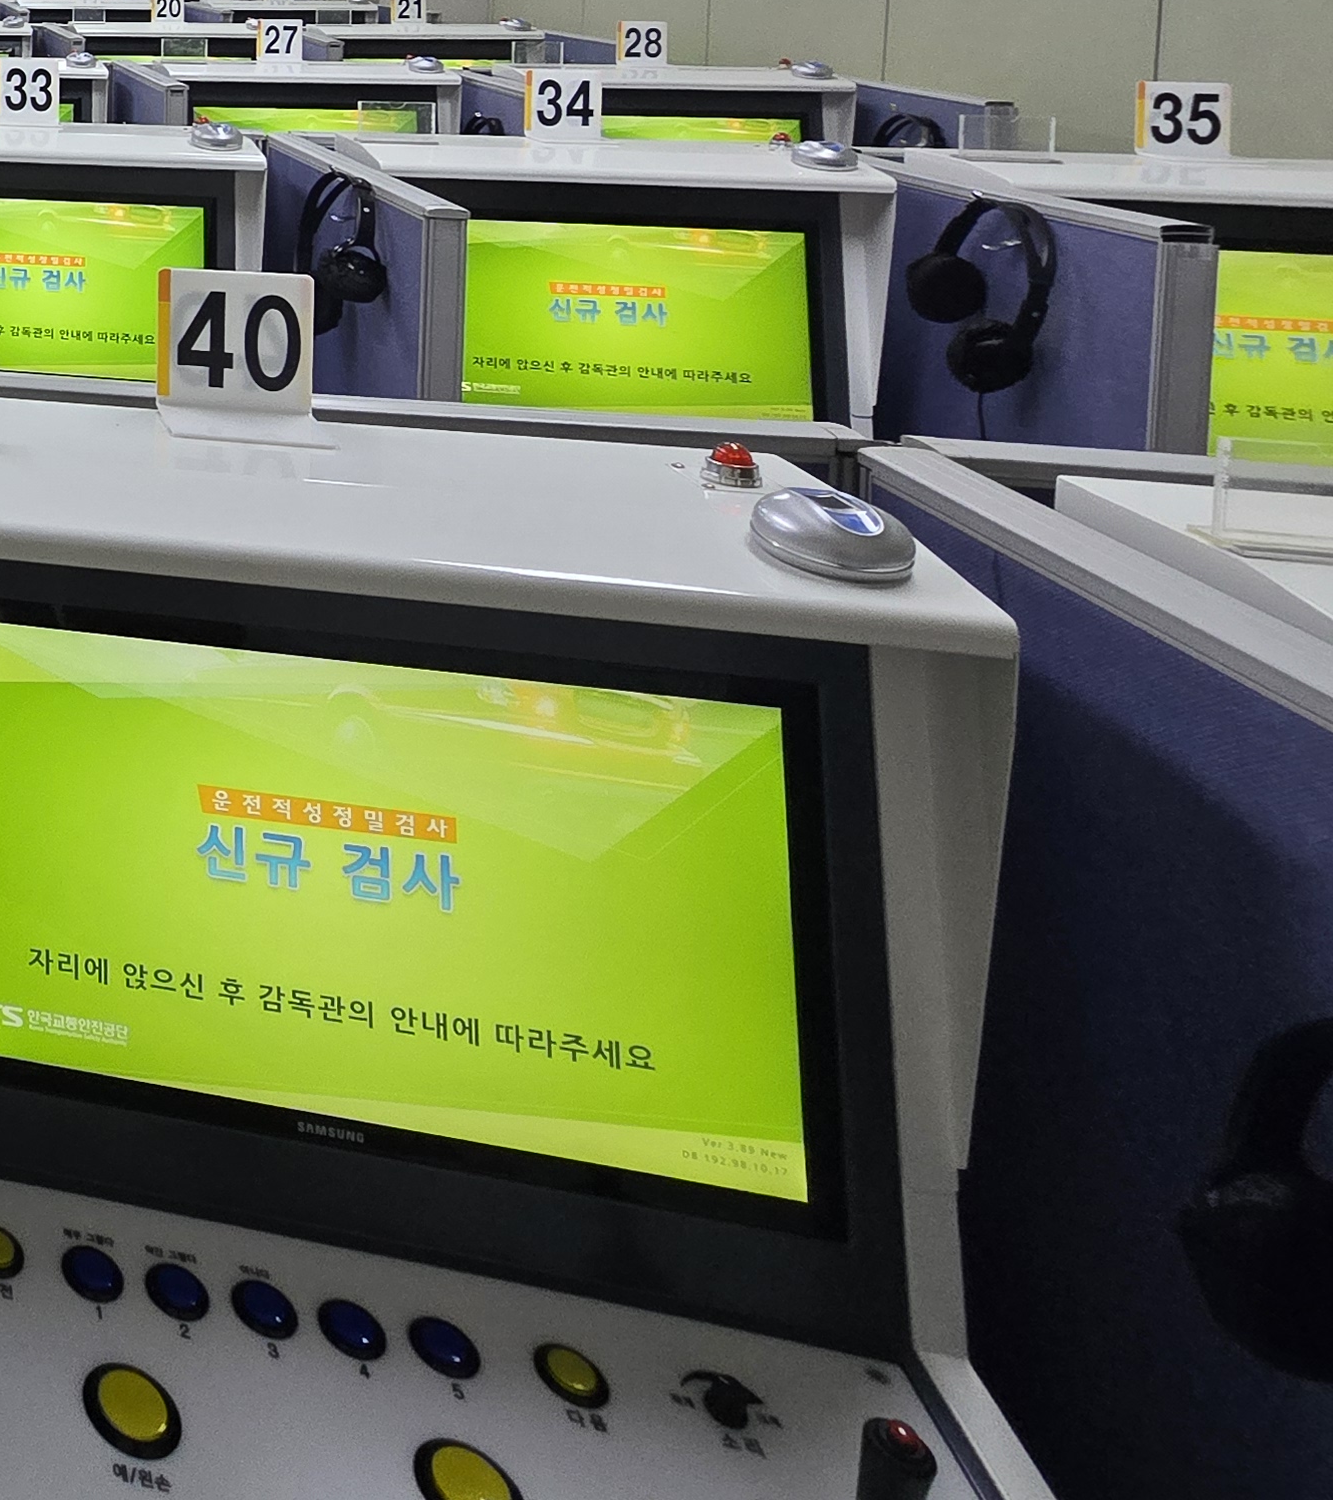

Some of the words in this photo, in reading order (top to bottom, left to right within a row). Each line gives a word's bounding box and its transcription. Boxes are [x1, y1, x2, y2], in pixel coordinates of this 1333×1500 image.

[265, 26, 297, 53] 27
[625, 28, 661, 57] 28
[5, 68, 52, 111] 33
[537, 80, 594, 126] 34
[1151, 93, 1221, 145] 35
[42, 270, 86, 293] 검사
[549, 299, 601, 323] 신규
[615, 301, 668, 327] 검사
[9, 326, 54, 340] 감독관의
[59, 329, 93, 342] 안내에
[97, 331, 156, 346] 따라주세요
[177, 291, 301, 391] 40
[472, 357, 511, 370] 자리에
[516, 358, 555, 373] 앉으신
[560, 361, 573, 374] 후
[578, 361, 631, 377] 감독관의
[637, 366, 678, 381] 안내에
[682, 369, 753, 385] 따라주세요
[1223, 403, 1240, 417] 후
[1246, 404, 1314, 422] 감독관의
[211, 789, 449, 839] 운전적성정밀검사
[196, 824, 312, 890] 신규
[341, 843, 461, 914] 검사
[28, 946, 110, 986] 자리에
[122, 961, 205, 1002] 앉으신
[218, 977, 246, 1006] 후
[259, 985, 375, 1030] 감독관의
[390, 1006, 481, 1047] 안내에
[495, 1021, 657, 1073] 따라주세요
[297, 1121, 364, 1144] SAMSUNG
[701, 1137, 722, 1148] Ver
[760, 1147, 788, 1160] New
[681, 1149, 698, 1160] DB
[704, 1153, 788, 1176] 192.98.10.17
[95, 1305, 103, 1320] 1
[179, 1323, 192, 1340] 2
[267, 1342, 280, 1359] 3
[359, 1363, 371, 1380] 4
[451, 1383, 465, 1400] 5
[111, 1463, 173, 1494] 예/왼손
